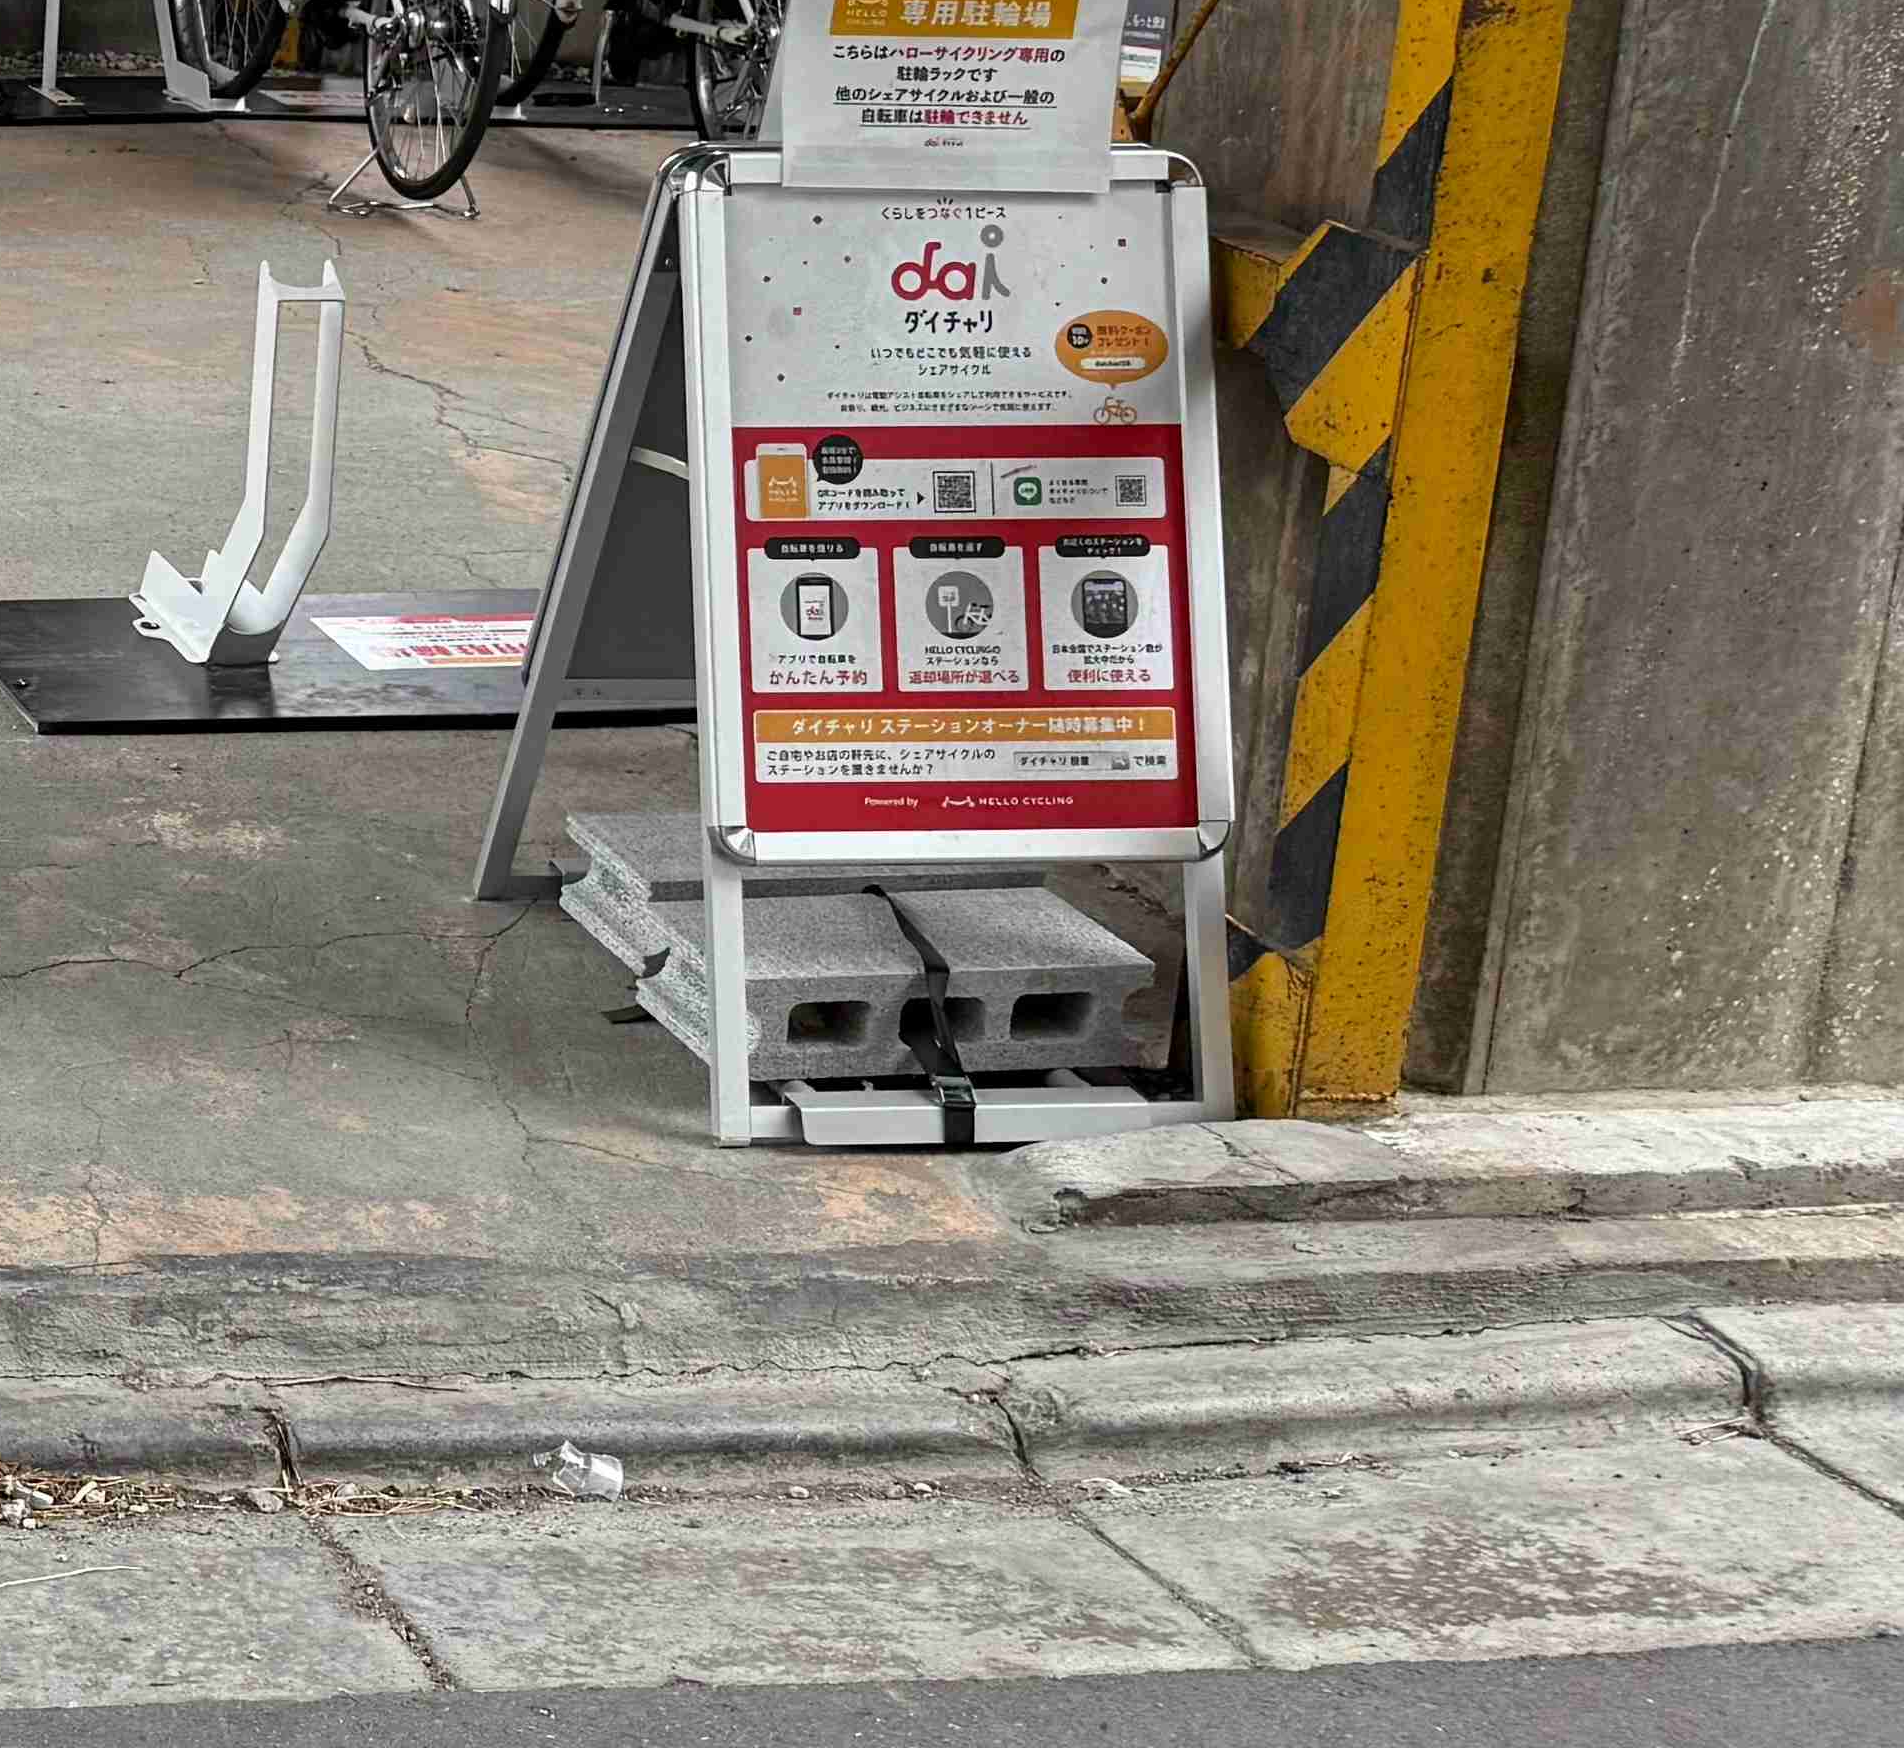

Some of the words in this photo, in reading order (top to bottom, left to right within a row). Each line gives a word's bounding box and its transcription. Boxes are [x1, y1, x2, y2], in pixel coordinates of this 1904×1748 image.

[900, 0, 1052, 28] 専用駐輪場
[833, 45, 1065, 63] こちらはハローサイクリング専用の
[896, 66, 997, 82] 駐輪ラックです
[835, 87, 1055, 104] 他のシェアサイクルおよび一般の
[861, 108, 1029, 125] 自転車は駐輪できません
[891, 224, 1011, 301] dai
[904, 309, 993, 334] ダイチャリ
[870, 346, 1032, 359] いつでもどこでも気軽に使える
[917, 364, 991, 376] シェアサイクル
[770, 669, 867, 686] かんたん予約
[1068, 669, 1151, 683] 便利に使える
[792, 718, 874, 735] ダイチャリ
[864, 797, 904, 806] Powered
[906, 797, 918, 809] by
[979, 797, 1018, 805] HELLO
[1022, 797, 1074, 805] CYCLING
